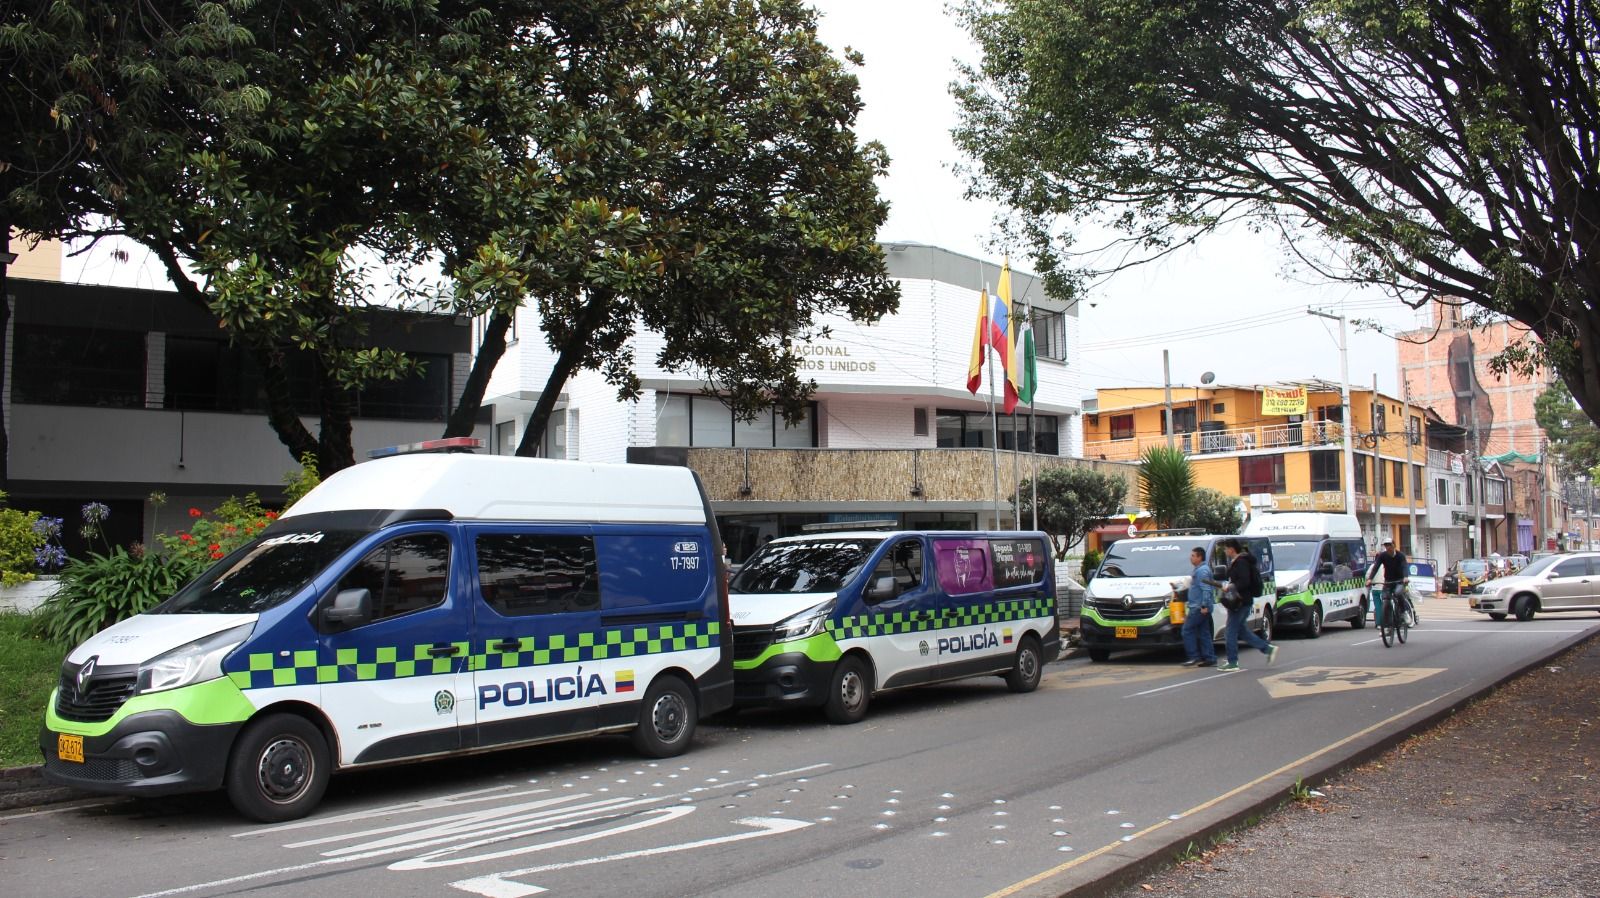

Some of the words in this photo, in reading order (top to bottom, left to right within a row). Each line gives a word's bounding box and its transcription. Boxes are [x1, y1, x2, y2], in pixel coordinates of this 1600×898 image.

[795, 360, 825, 371] RIOS
[830, 361, 877, 372] UNIDOS
[682, 543, 697, 551] 123
[770, 542, 859, 554] POLICÍA
[1131, 544, 1181, 553] POLICÍA
[670, 556, 700, 570] 17-7997
[938, 627, 999, 655] POLICÍA
[478, 666, 607, 710] POLICÍA
